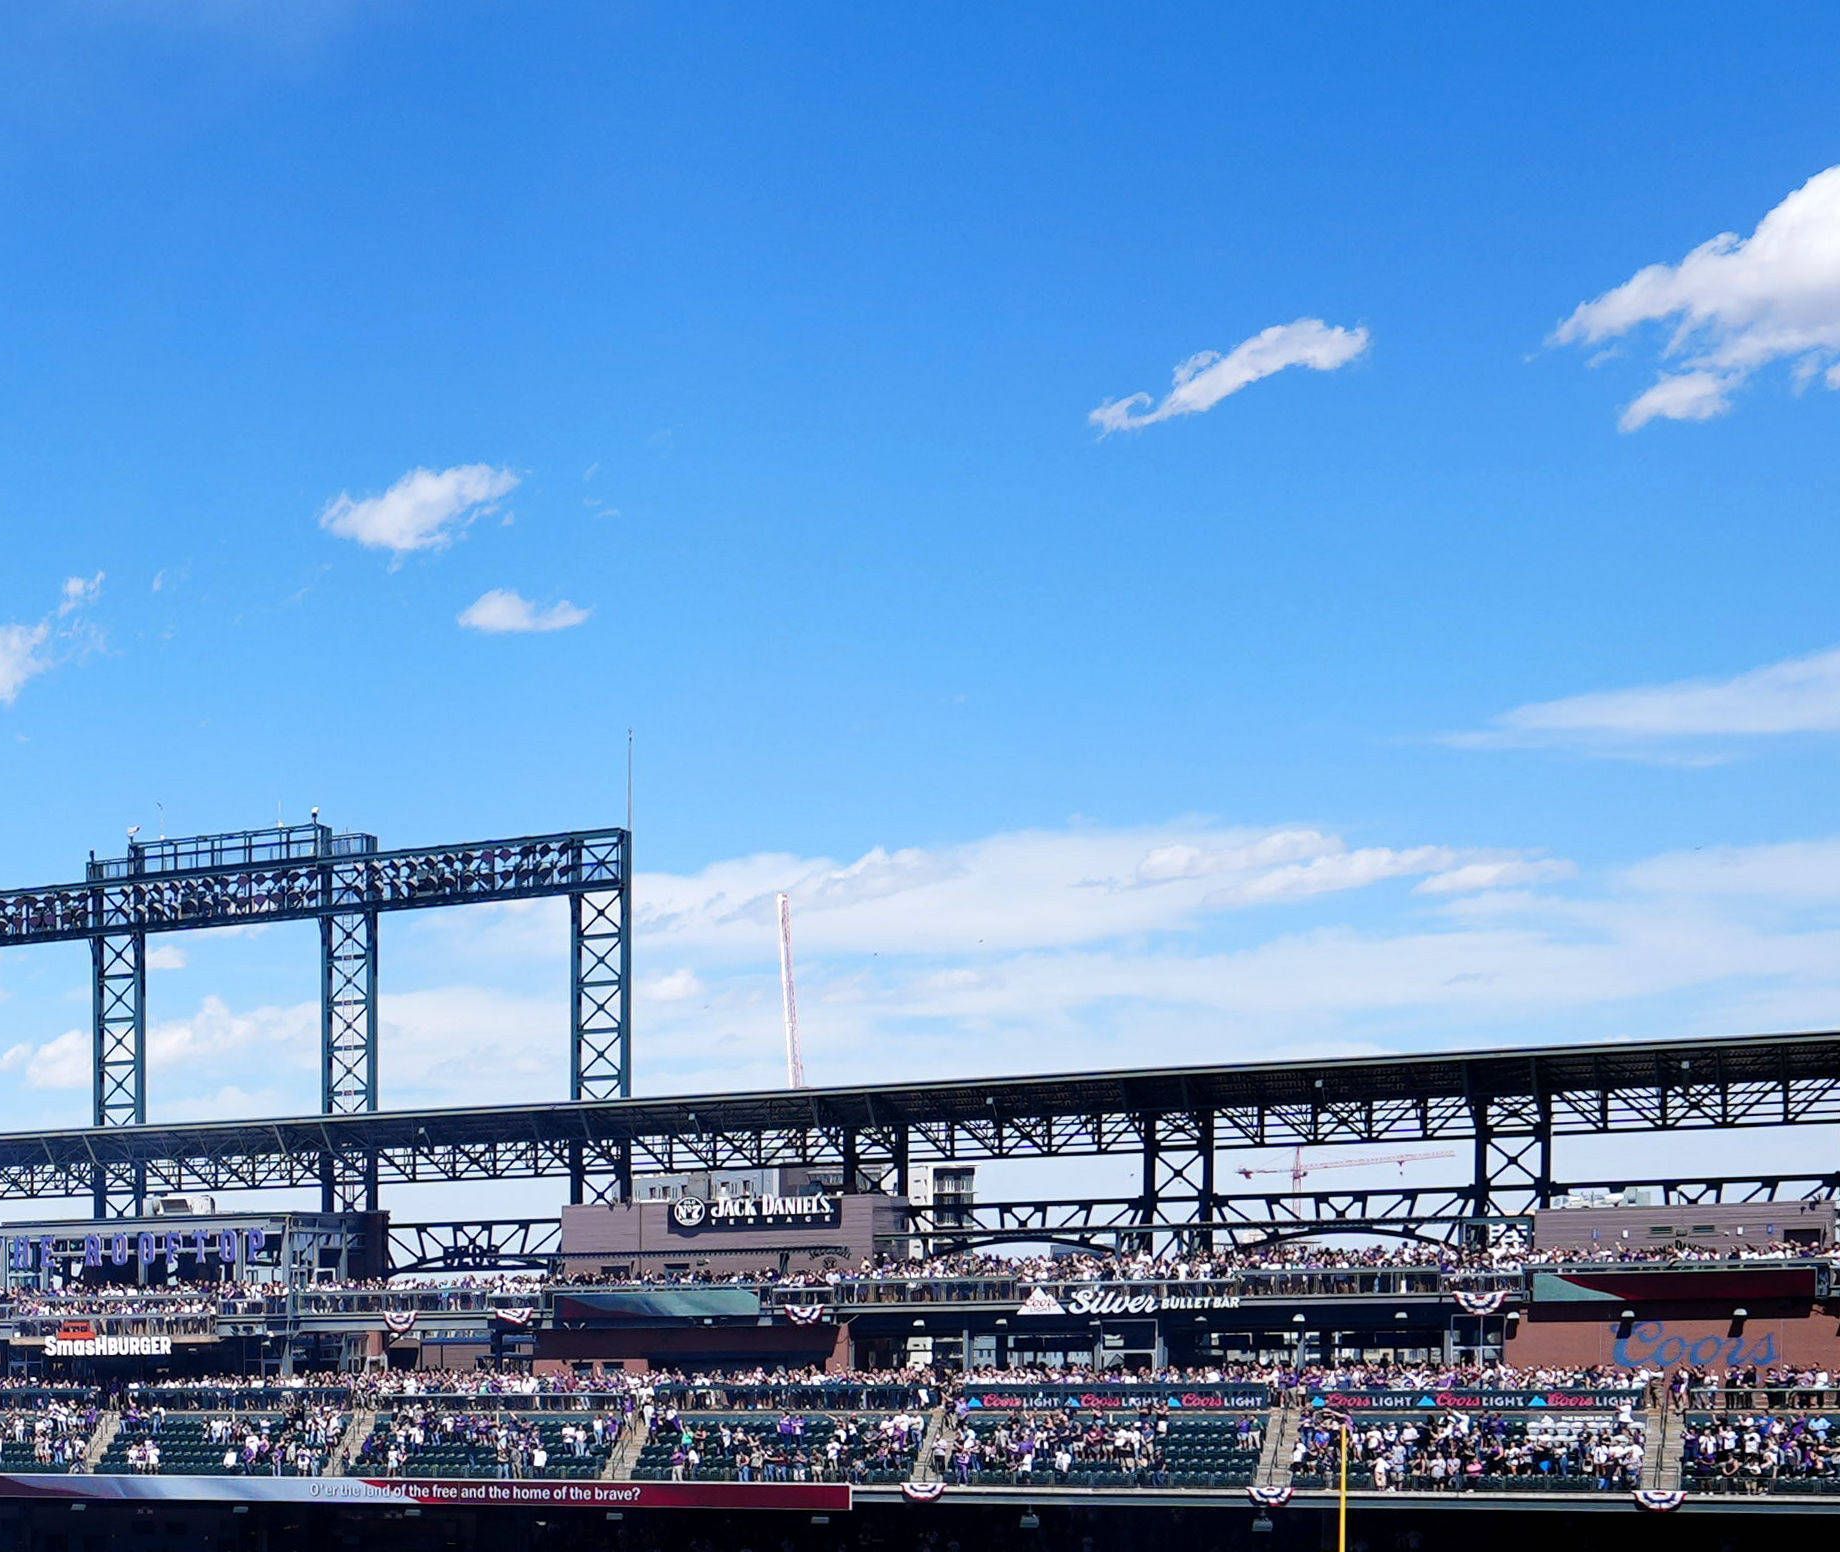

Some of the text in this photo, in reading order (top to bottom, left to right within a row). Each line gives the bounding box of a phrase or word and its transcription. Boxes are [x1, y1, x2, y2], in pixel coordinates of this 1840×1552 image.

[710, 1195, 758, 1218] JACK
[711, 1215, 831, 1226] TERRACE
[82, 1229, 266, 1267] ROOFTOP
[1069, 1290, 1241, 1315] Silver BULLET BAR
[1613, 1320, 1777, 1368] Coors
[1023, 1396, 1061, 1408] LIGHT
[1223, 1396, 1262, 1408] LIGHT
[1372, 1396, 1413, 1408] LIGHT
[1482, 1396, 1525, 1408] LIGHT
[340, 1486, 361, 1498] the
[363, 1486, 390, 1498] land
[394, 1486, 407, 1498] of
[408, 1486, 430, 1498] the
[432, 1486, 458, 1498] free
[460, 1487, 484, 1499] and
[488, 1487, 510, 1499] the
[512, 1488, 550, 1500] home
[553, 1488, 567, 1500] of
[570, 1488, 592, 1500] the
[594, 1488, 641, 1501] brave?
